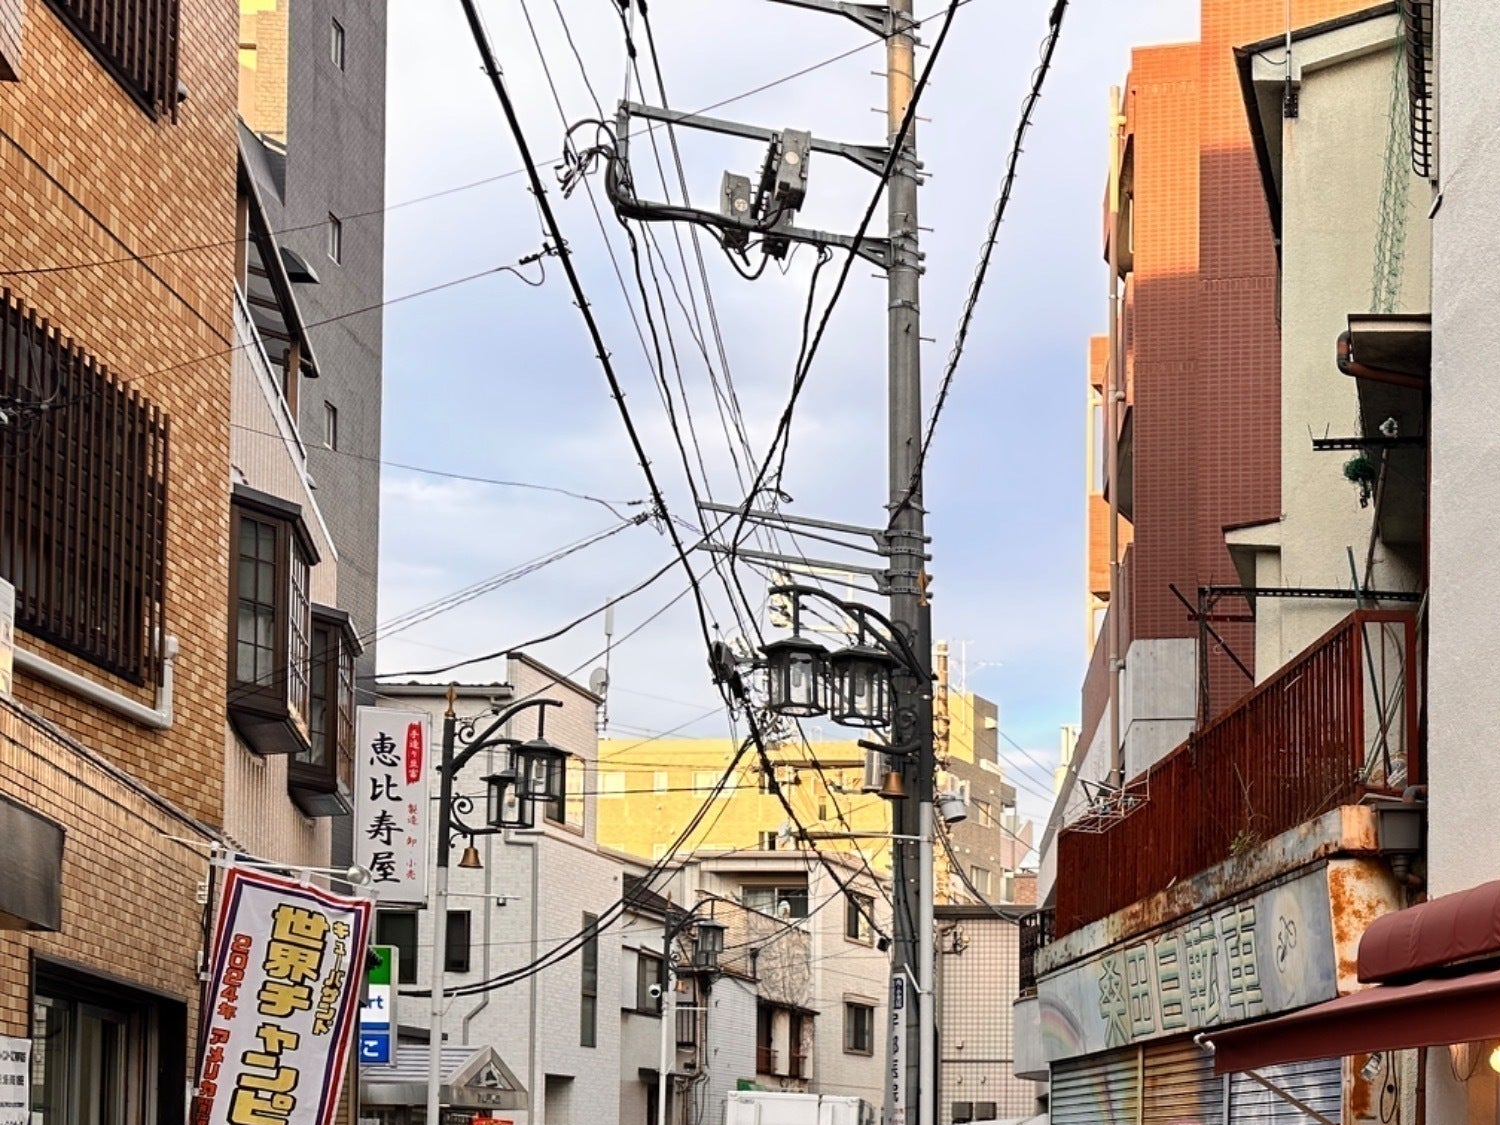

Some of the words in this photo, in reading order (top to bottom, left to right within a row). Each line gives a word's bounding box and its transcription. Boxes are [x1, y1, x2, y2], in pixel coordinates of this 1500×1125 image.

[366, 732, 404, 884] 恵比寿屋
[217, 933, 253, 1021] 2024年
[312, 920, 350, 1037] キューバサンド
[1098, 904, 1264, 1049] 桑田自転車
